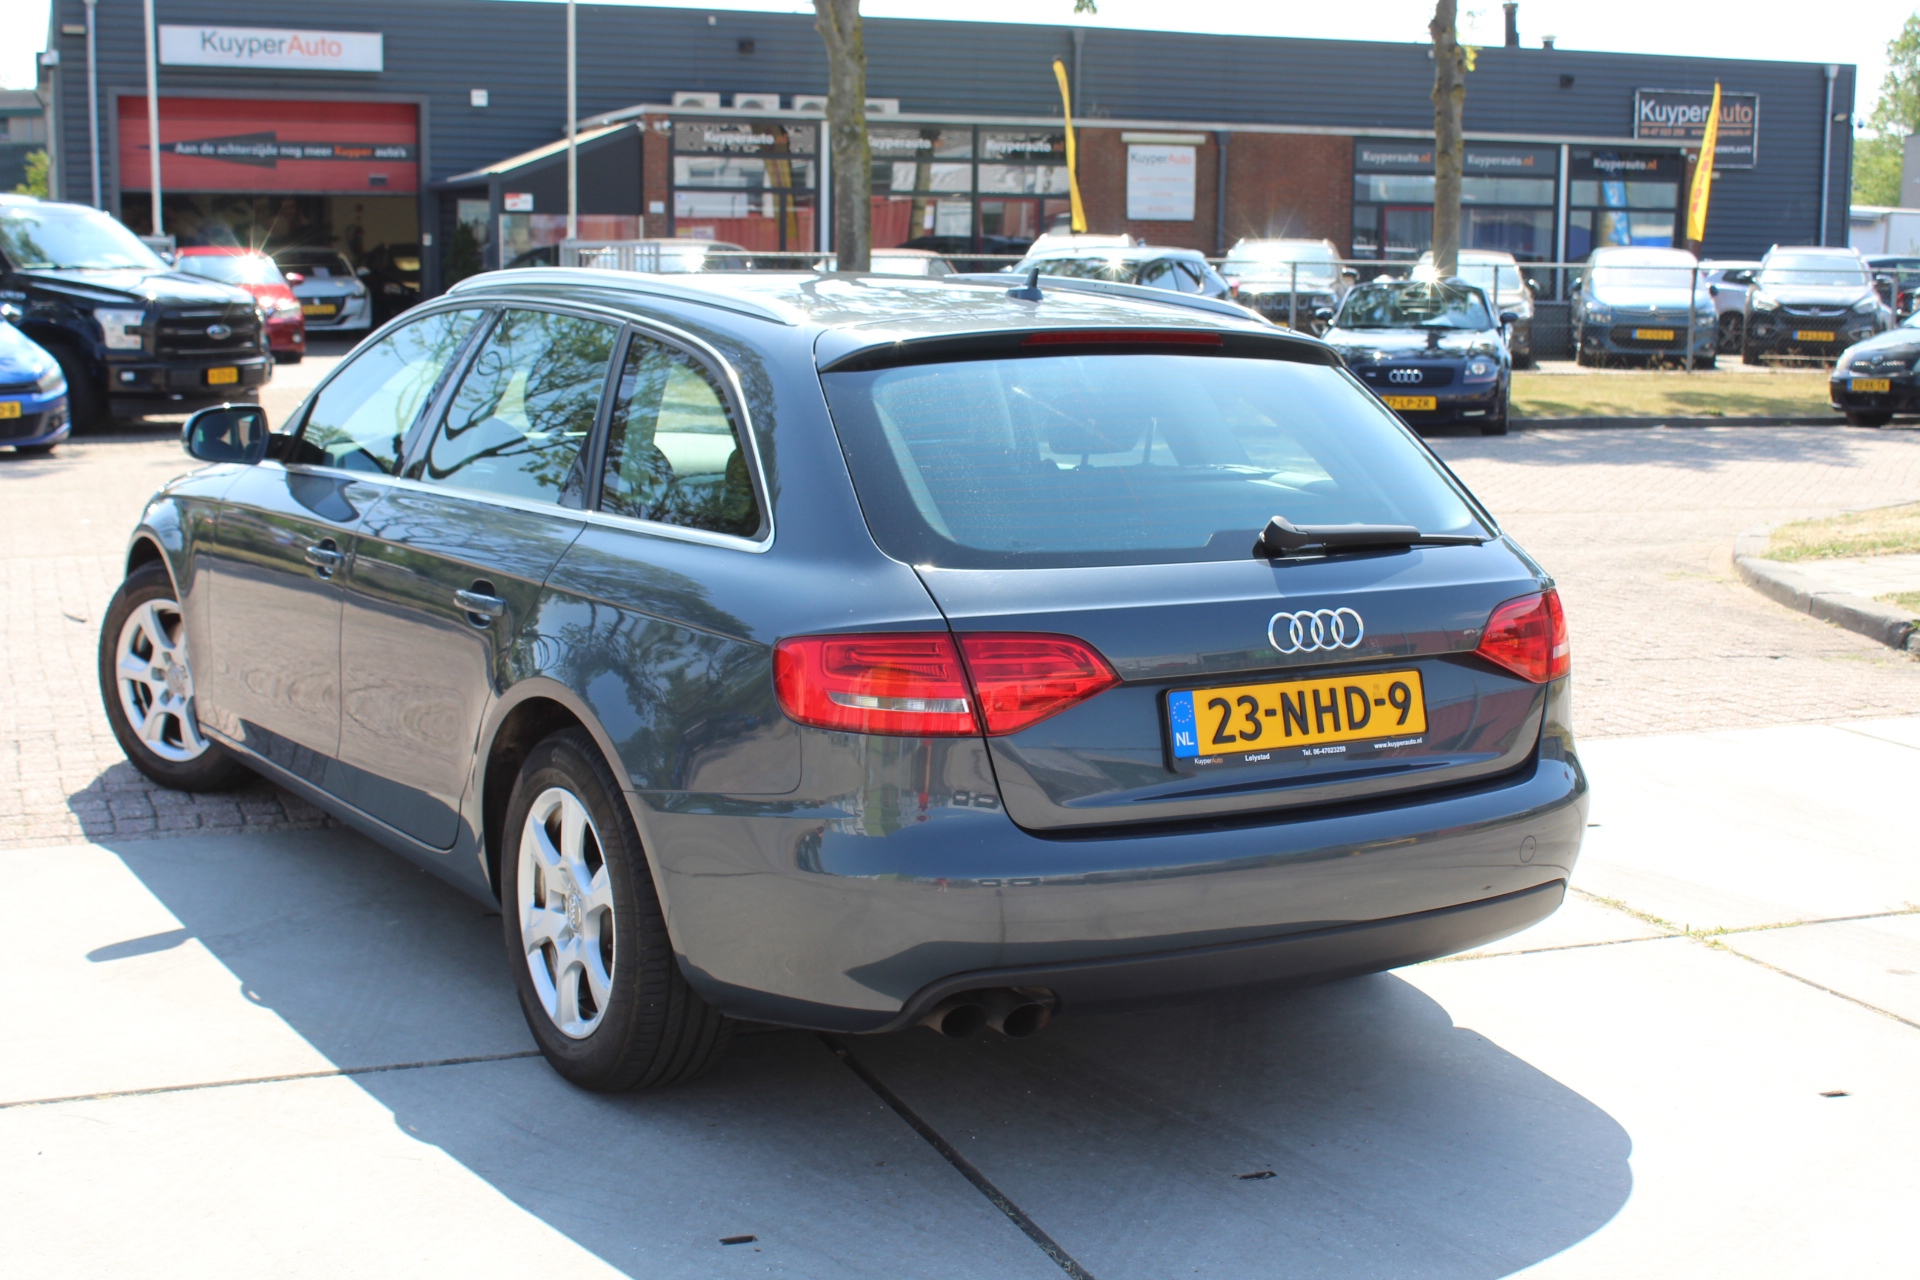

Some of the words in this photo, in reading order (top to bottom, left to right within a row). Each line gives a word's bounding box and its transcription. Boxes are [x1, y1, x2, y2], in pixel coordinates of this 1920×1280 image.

[200, 31, 343, 58] KuyperAuto
[175, 142, 199, 155] Aan
[200, 142, 215, 155] de
[217, 142, 279, 158] achterzijde
[280, 146, 302, 158] nog
[304, 147, 332, 156] meer
[334, 146, 373, 158] Kuyper
[1131, 152, 1192, 167] KuyperAuto
[1362, 151, 1431, 165] Kuyperauto.nl
[1467, 154, 1534, 168] Kuyperauto.nl
[1593, 158, 1658, 172] Kuyperauto.nl
[1207, 681, 1412, 745] 23-NHD-9
[1175, 732, 1195, 747] NL
[1373, 737, 1423, 750] www.kuyperauto.nl
[1244, 753, 1270, 763] Lelystad
[1302, 749, 1313, 757] Tel.
[1194, 756, 1223, 766] KuyperAuto
